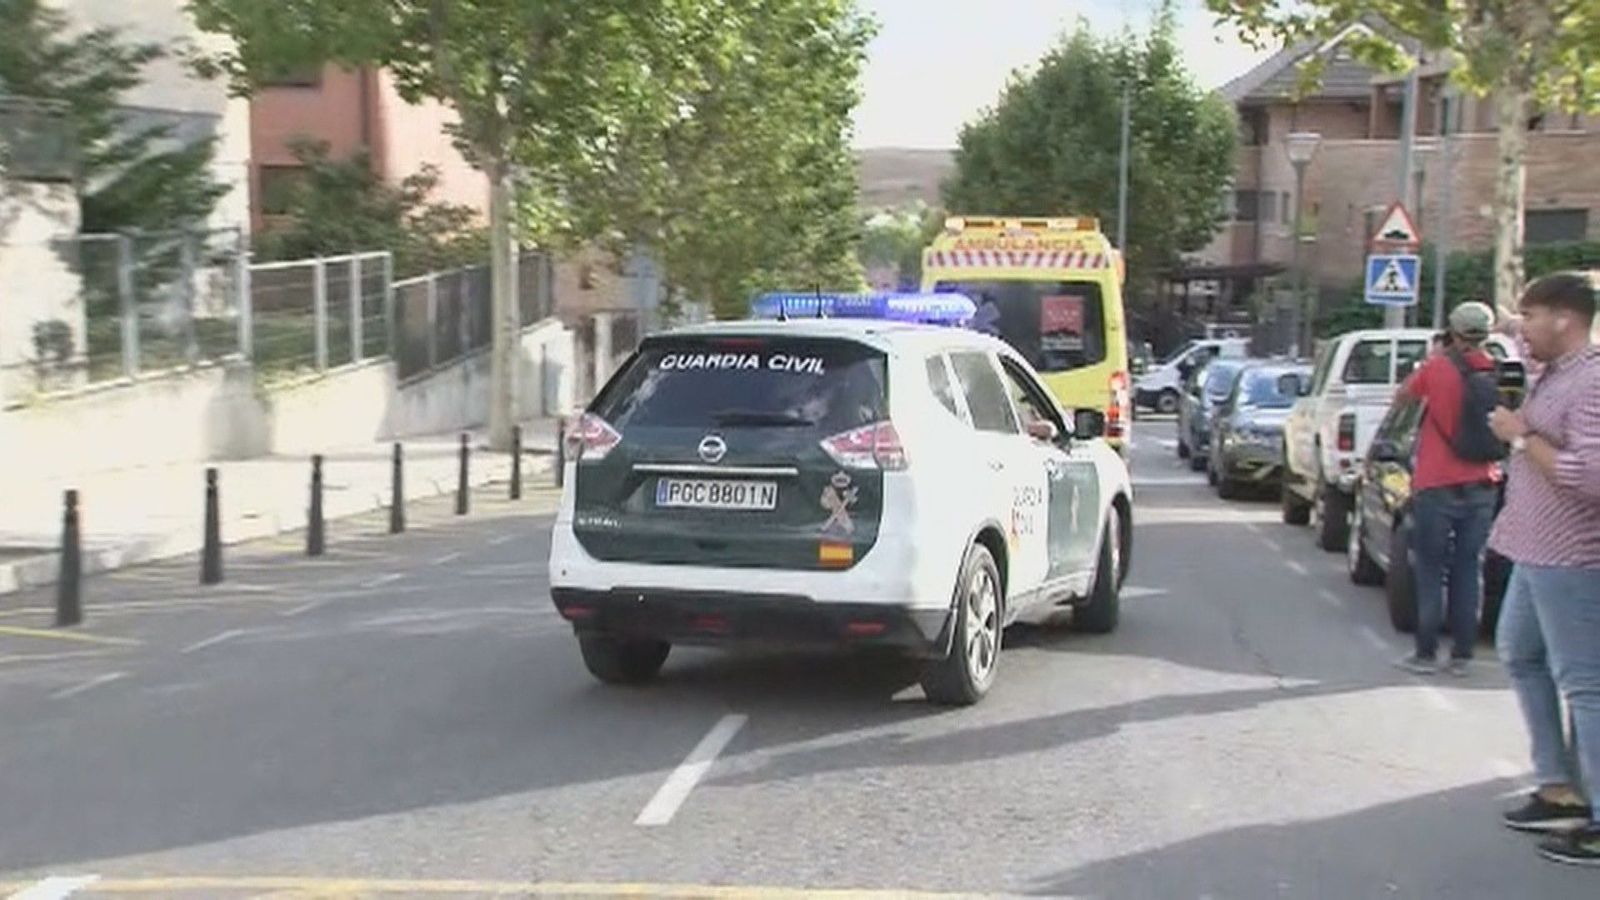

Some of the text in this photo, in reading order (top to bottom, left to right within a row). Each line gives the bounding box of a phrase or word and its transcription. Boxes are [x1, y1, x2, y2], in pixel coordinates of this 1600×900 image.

[953, 237, 1085, 251] AMBULANCIA
[659, 353, 825, 375] GUARDIA CIVIL
